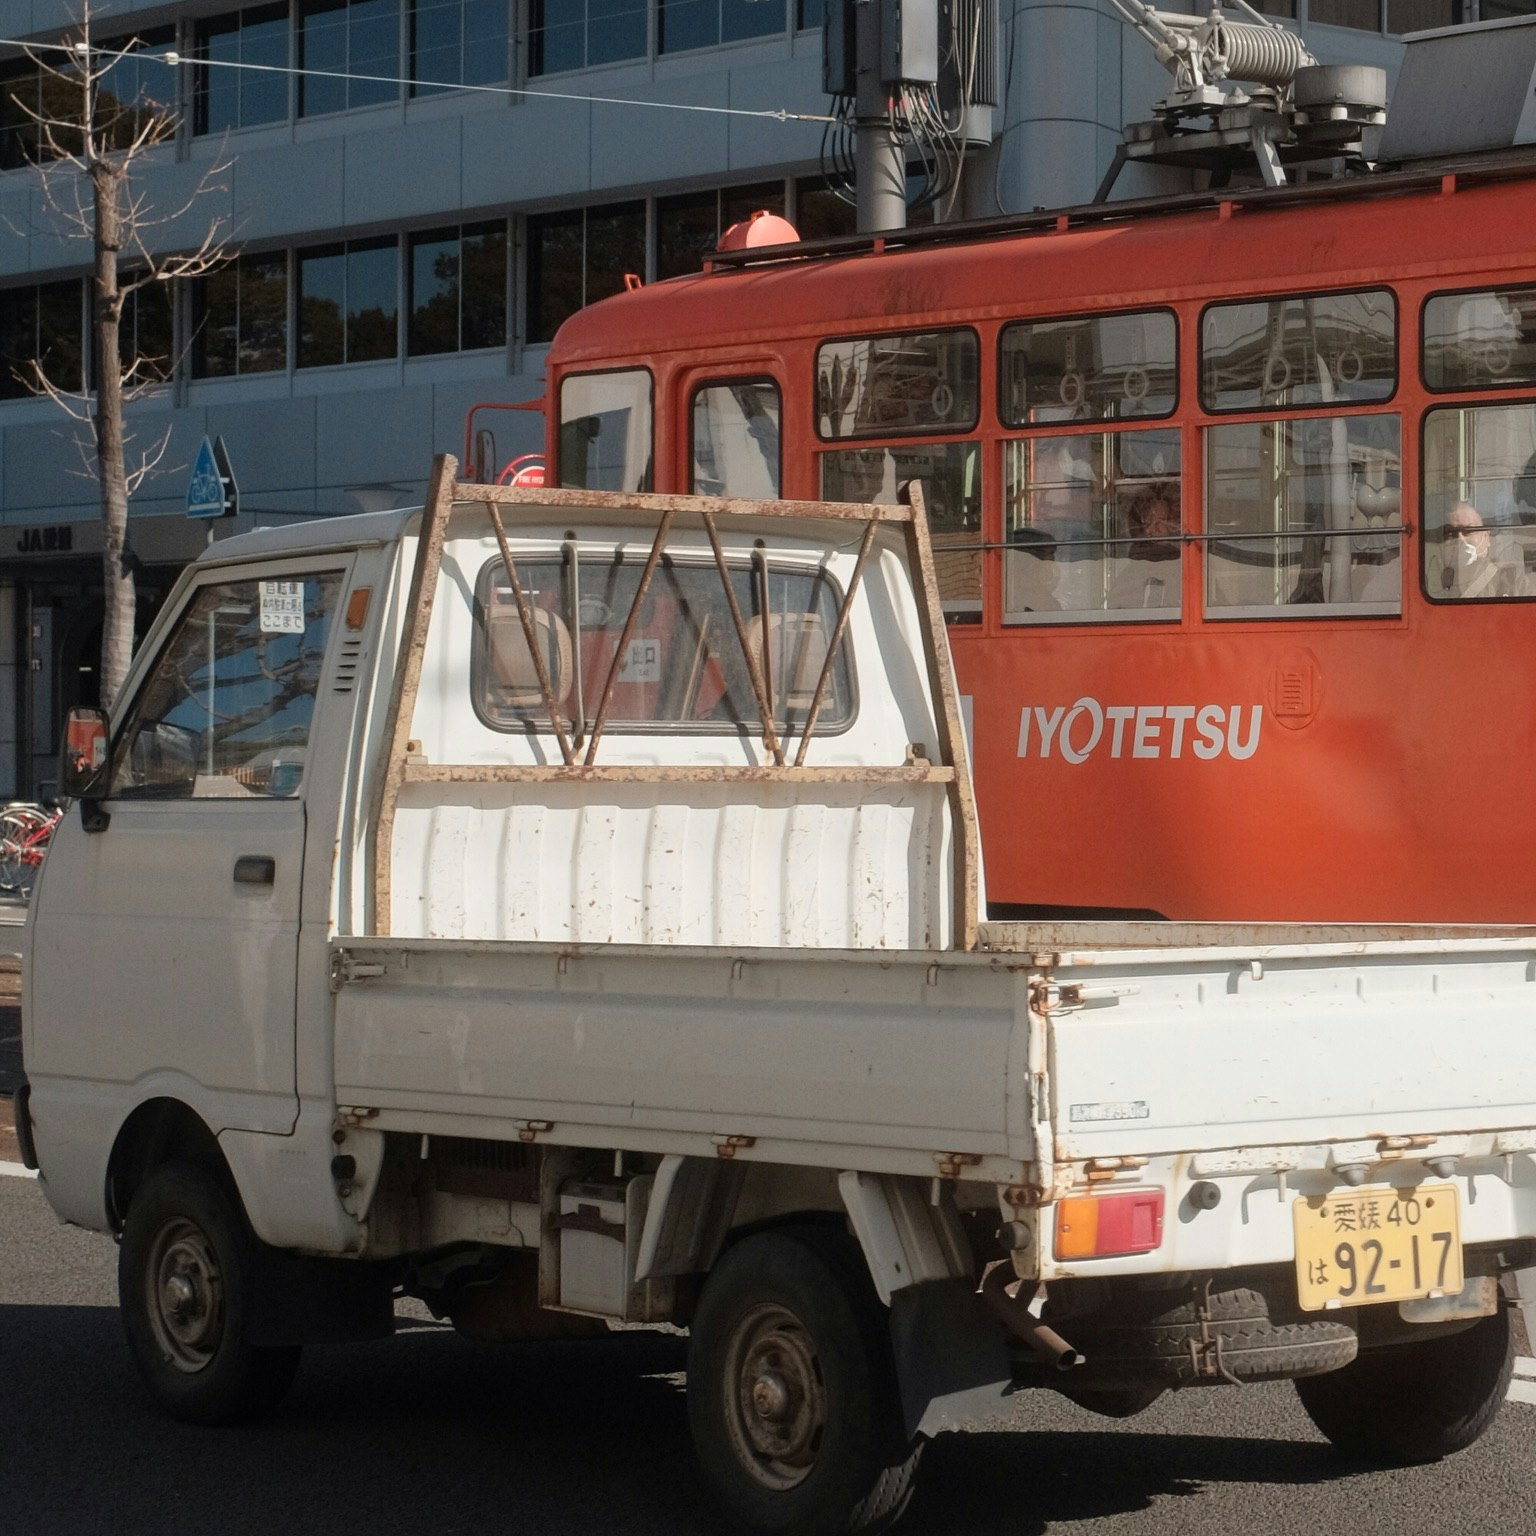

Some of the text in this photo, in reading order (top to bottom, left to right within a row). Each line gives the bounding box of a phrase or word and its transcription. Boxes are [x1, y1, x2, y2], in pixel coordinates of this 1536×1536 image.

[262, 615, 302, 628] ここまで
[1017, 696, 1263, 765] IYOTETSU
[1333, 1198, 1421, 1233] 愛媛 40
[1308, 1231, 1452, 1297] は 92-17
